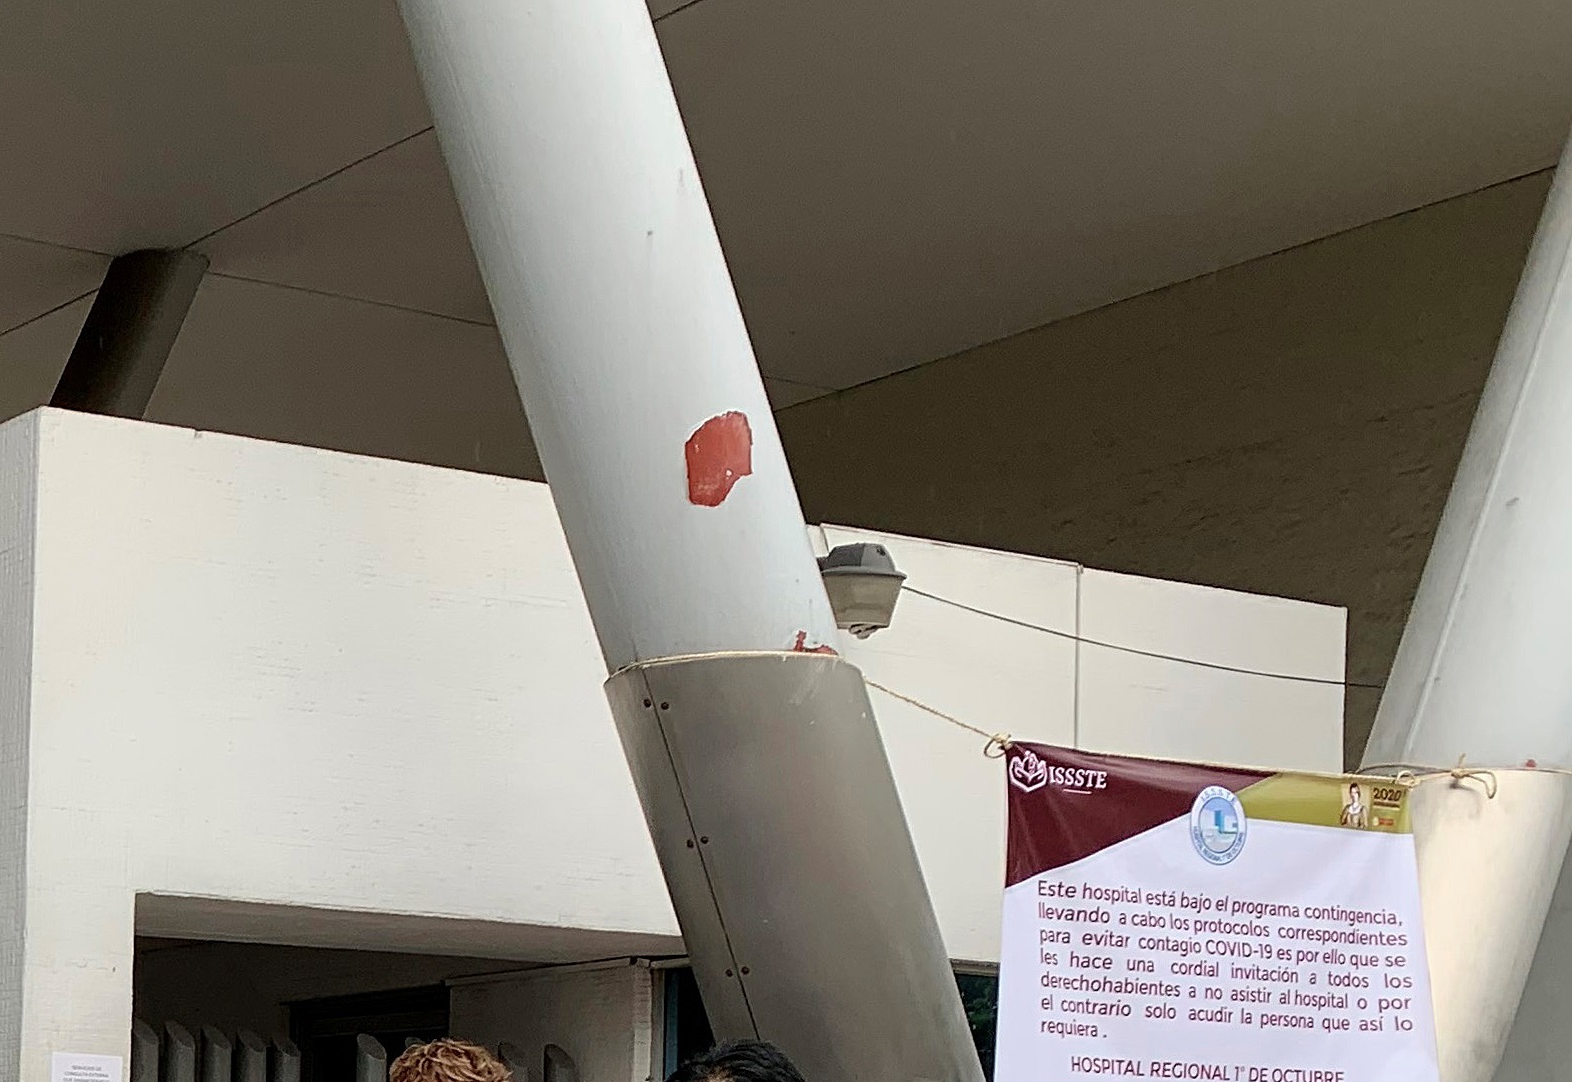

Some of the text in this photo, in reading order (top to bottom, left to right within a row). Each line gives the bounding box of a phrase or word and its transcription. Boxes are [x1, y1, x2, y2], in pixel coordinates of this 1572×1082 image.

[1048, 766, 1108, 789] ISSSTE
[1373, 787, 1402, 802] 2020
[1038, 880, 1403, 927] Este hospital está bajo el programa contingencia,
[1039, 902, 1408, 947] llevando a cabo los protocolos correspondientes
[1040, 929, 1407, 970] para evitar contagio COVID-19 es por ello que se
[1040, 948, 1413, 989] les hace una cordial invitación a todos los
[1041, 971, 1412, 1013] derechohabientes a no asistir al hospital o por
[1041, 994, 1413, 1033] el contrario solo acudir la persona que así lo
[1041, 1019, 1098, 1038] requiera
[1071, 1056, 1145, 1077] HOSPITAL
[1150, 1061, 1230, 1081] REGIONAL
[1248, 1067, 1268, 1082] DE
